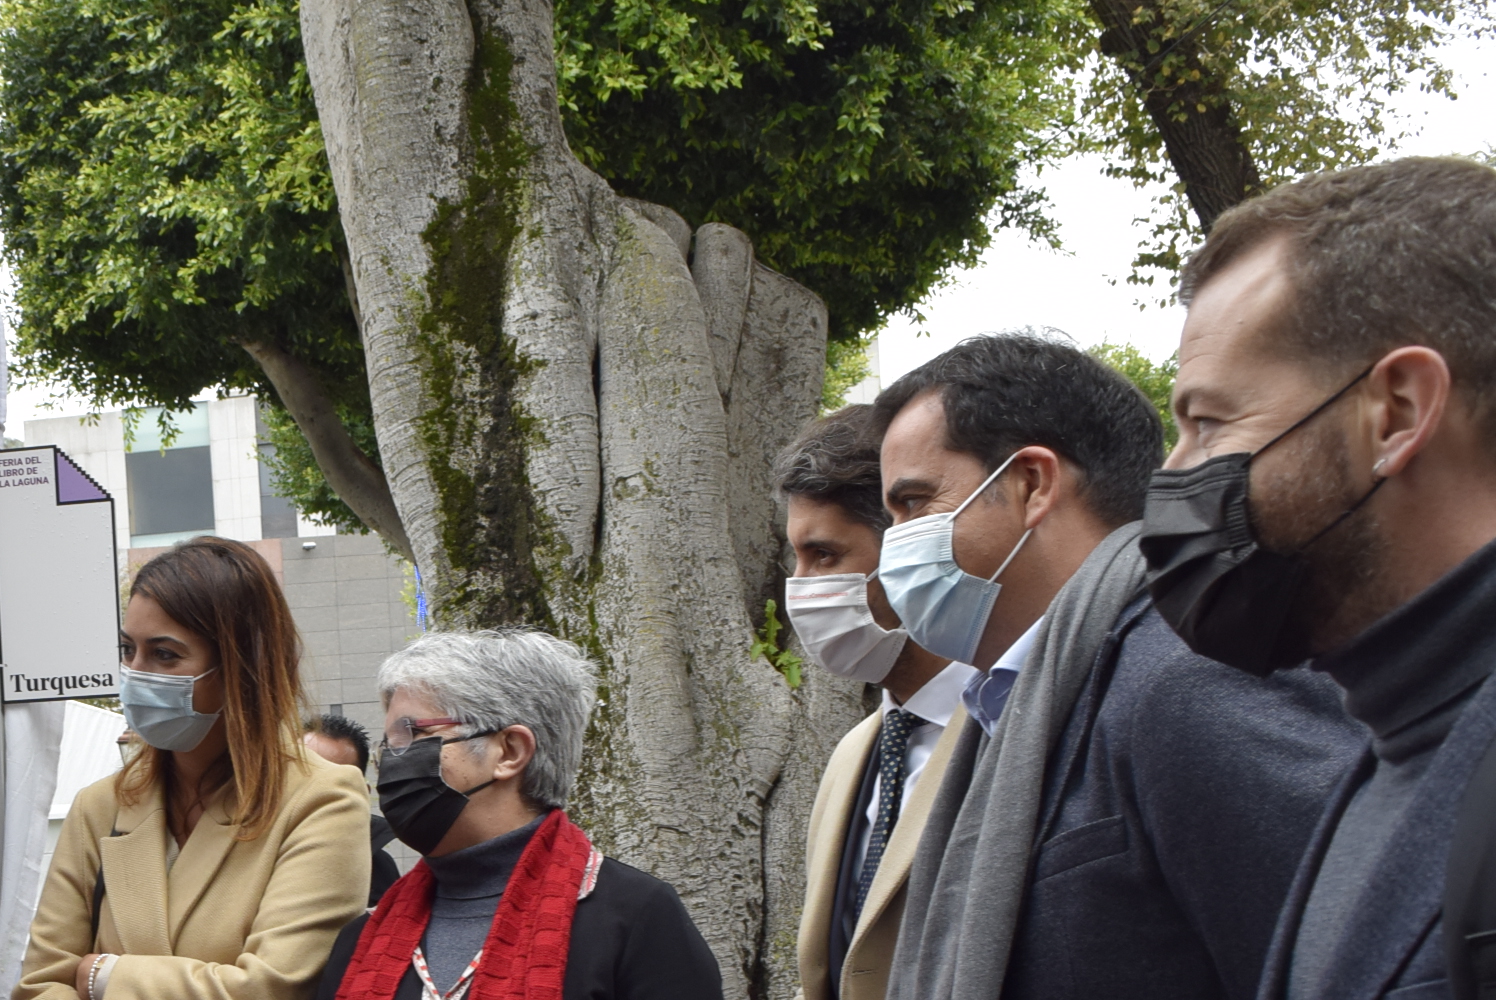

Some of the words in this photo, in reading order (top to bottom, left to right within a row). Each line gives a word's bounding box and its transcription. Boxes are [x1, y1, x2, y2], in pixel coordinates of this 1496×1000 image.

[25, 455, 42, 465] DEL
[25, 466, 39, 476] DE
[12, 475, 50, 487] LAGUNA
[9, 671, 115, 696] Turquesa
